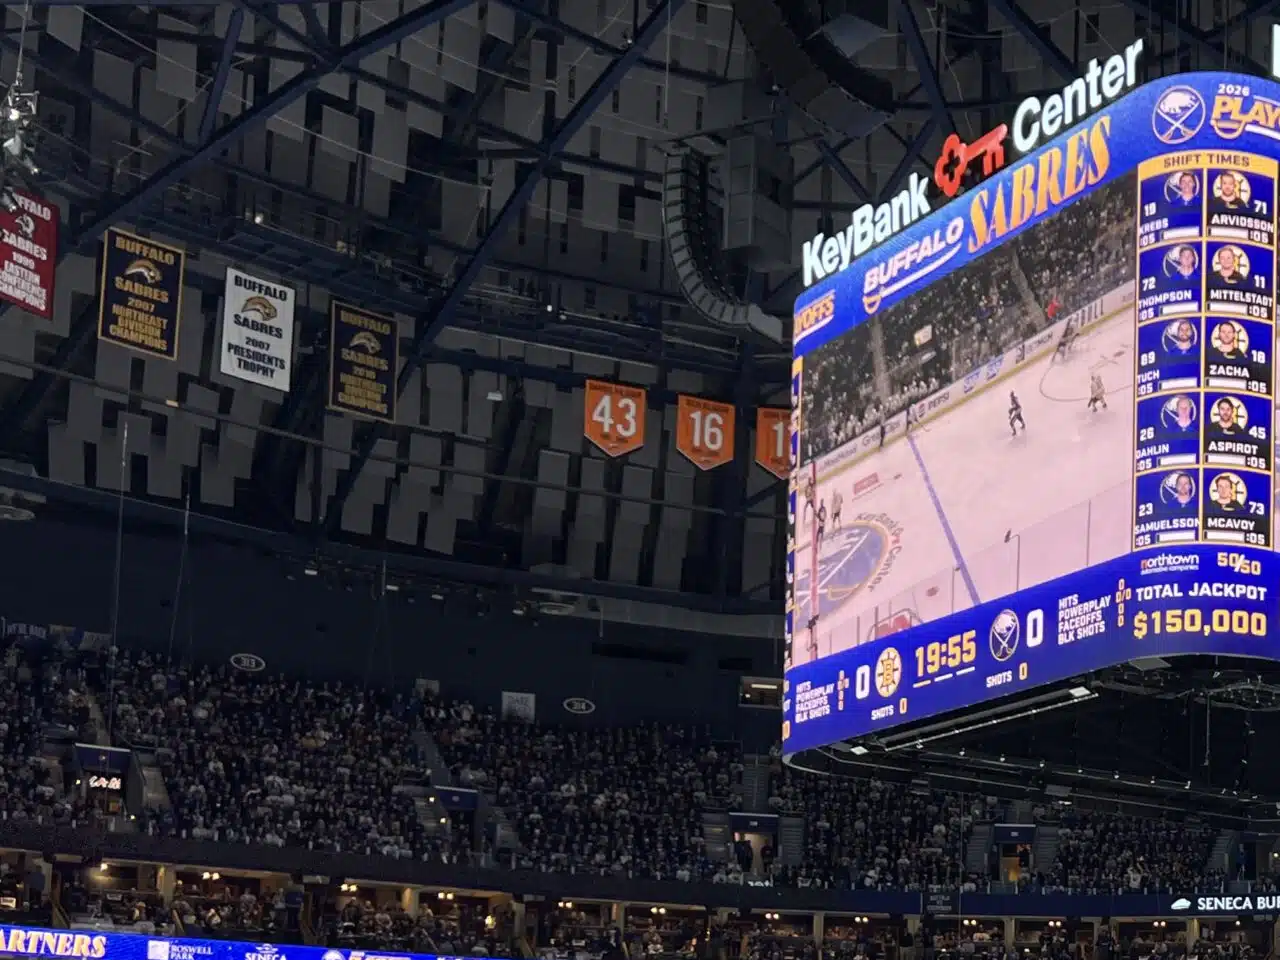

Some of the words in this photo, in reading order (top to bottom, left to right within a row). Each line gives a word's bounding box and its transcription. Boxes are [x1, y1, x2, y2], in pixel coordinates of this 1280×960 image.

[1217, 83, 1251, 97] 2026
[802, 172, 931, 287] KeyBank
[1012, 38, 1144, 152] Center
[1163, 154, 1202, 169] SHIFT
[1206, 153, 1251, 168] TIMES
[968, 116, 1112, 254] SABRES
[1254, 200, 1268, 215] 71
[1139, 218, 1169, 236] KREBS
[1211, 214, 1274, 232] ARVIDSSON
[115, 236, 175, 265] BUFFALO
[864, 216, 965, 293] BUFFALO
[114, 277, 169, 303] SABRES
[234, 275, 288, 302] BUFFALO
[1254, 275, 1266, 289] 11
[1138, 290, 1192, 309] THOMPSON
[1210, 289, 1273, 308] MITTELSTADT
[112, 303, 169, 330] NORTHEAST
[233, 313, 283, 339] SABRES
[109, 324, 167, 351] CHAMPIONS
[245, 336, 271, 351] 2007
[227, 342, 286, 370] PRESIDENTS
[1251, 350, 1265, 364] 18
[237, 357, 275, 379] TROPHY
[1137, 370, 1160, 384] TUCH
[1209, 364, 1250, 378] ZACHA
[592, 394, 637, 437] 43
[689, 410, 724, 451] 16
[1249, 425, 1266, 440] 45
[1136, 443, 1170, 460] DAHLIN
[1208, 440, 1259, 456] ASPIROT
[1249, 501, 1265, 515] 73
[1135, 517, 1200, 534] SAMUELSSON
[1207, 517, 1256, 531] MCAVOY
[1140, 553, 1200, 570] northtown
[1216, 551, 1262, 576] 50/50
[1058, 594, 1079, 610] HITS
[1136, 582, 1183, 602] TOTAL
[1188, 582, 1267, 602] JACKPOT
[1058, 595, 1112, 622] POWERPLAY
[1026, 608, 1044, 648] 0
[1058, 610, 1102, 633] FACEOFFS
[1133, 608, 1267, 640] $150,000
[1057, 629, 1075, 645] BLK
[1076, 620, 1106, 642] SHOTS
[915, 630, 977, 677] 19:55
[855, 665, 871, 700] 0
[986, 671, 1013, 688] SHOTS
[1018, 662, 1028, 681] 0
[871, 704, 894, 721] SHOTS
[1197, 896, 1253, 911] SENECA
